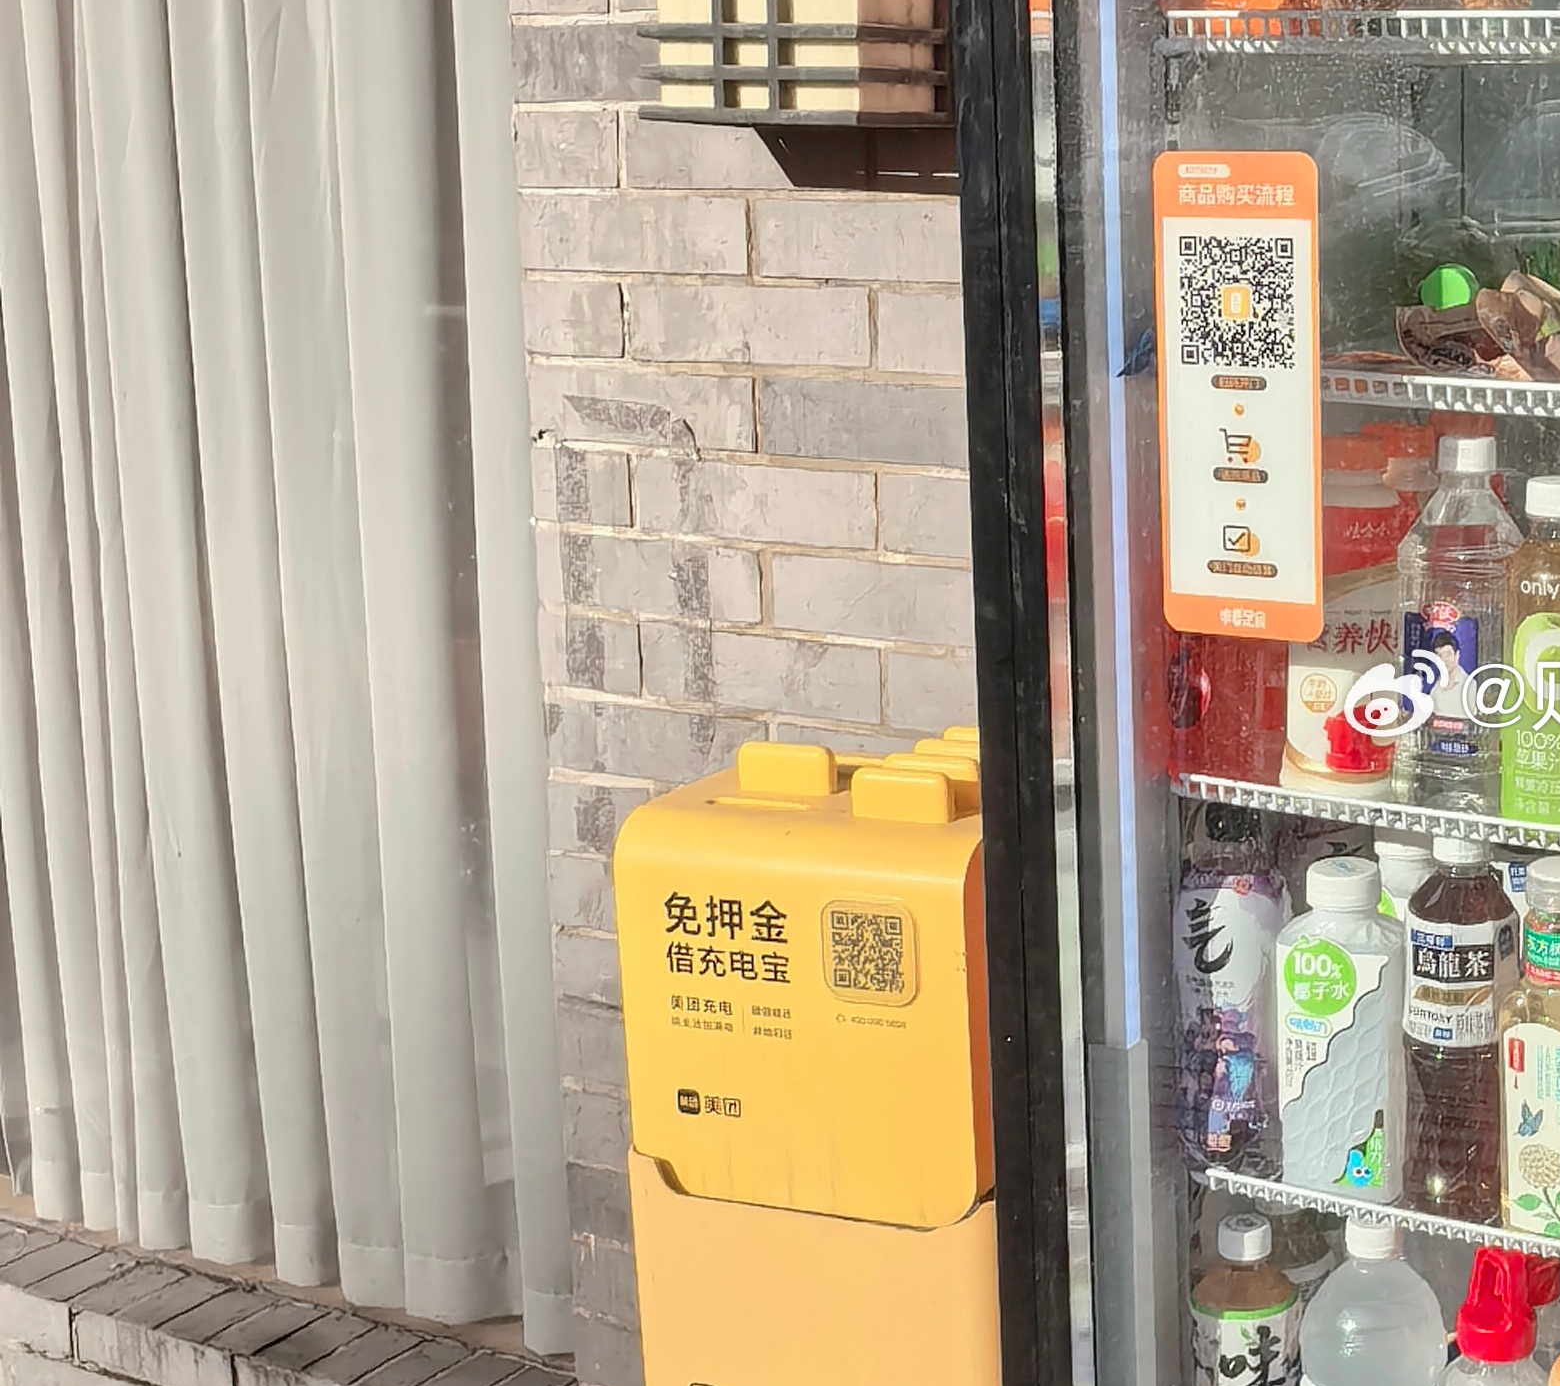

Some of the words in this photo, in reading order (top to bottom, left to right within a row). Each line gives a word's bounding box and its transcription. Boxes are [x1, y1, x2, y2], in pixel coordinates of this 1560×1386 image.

[1178, 184, 1296, 206] 商品购买流程
[664, 892, 788, 944] 免押金
[666, 941, 791, 984] 借充电宝
[1293, 950, 1343, 980] 100%
[1293, 980, 1351, 1002] 椰子水
[704, 1094, 741, 1118] 美团
